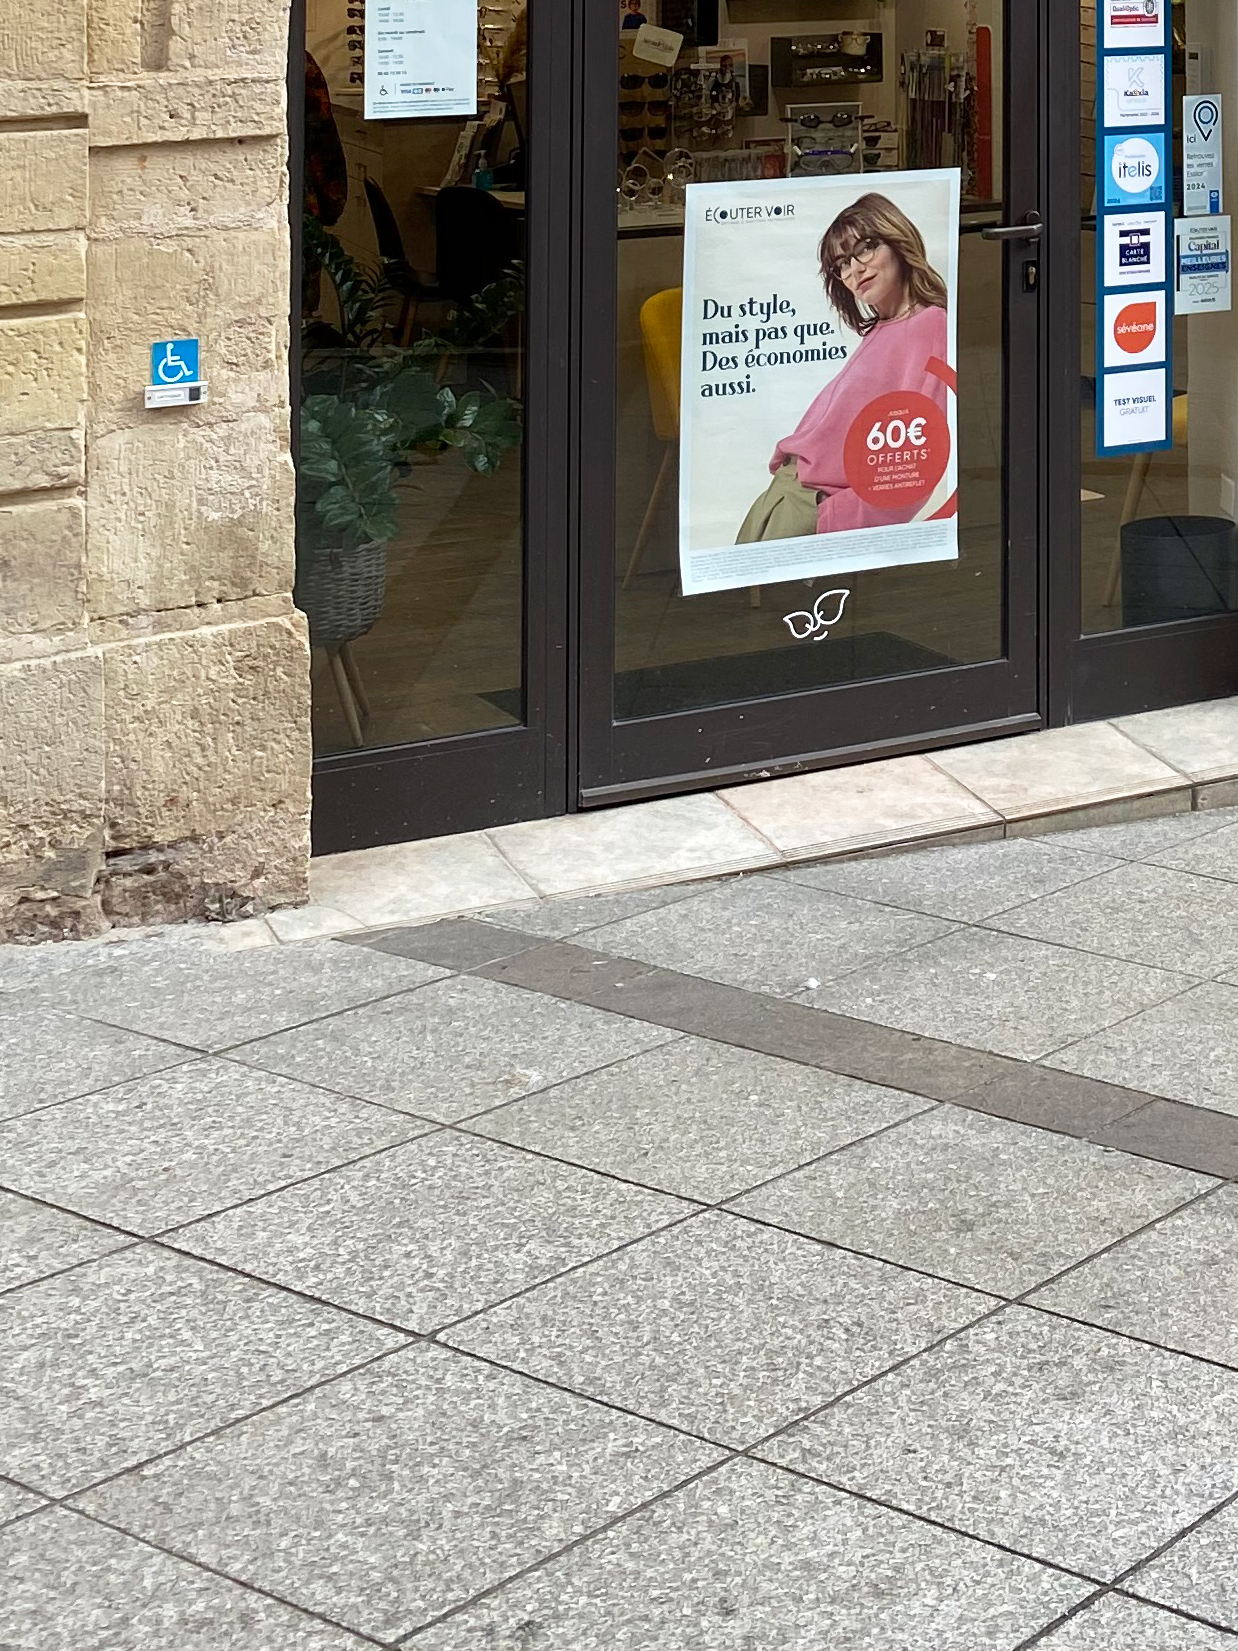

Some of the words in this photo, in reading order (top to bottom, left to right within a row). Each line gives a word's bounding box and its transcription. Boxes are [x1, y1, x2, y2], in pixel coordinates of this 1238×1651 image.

[1118, 161, 1152, 178] itelis
[1187, 182, 1206, 191] 2024
[705, 206, 762, 224] ÉCOUTER
[765, 204, 795, 218] VOIR
[1125, 248, 1144, 256] CARTE
[1188, 240, 1220, 254] Capital
[1189, 281, 1219, 297] 2025
[703, 299, 732, 320] Du
[738, 294, 796, 323] style,
[701, 324, 749, 346] mais
[754, 325, 788, 350] pas
[793, 321, 835, 346] que.
[701, 350, 739, 372] Des
[744, 341, 848, 368] économies
[700, 374, 756, 398] aussi.
[1113, 397, 1131, 406] TEST
[1132, 395, 1157, 404] VISUEL
[1120, 405, 1150, 416] GRATUIT
[866, 416, 927, 451] 60€
[877, 465, 894, 473] POUR
